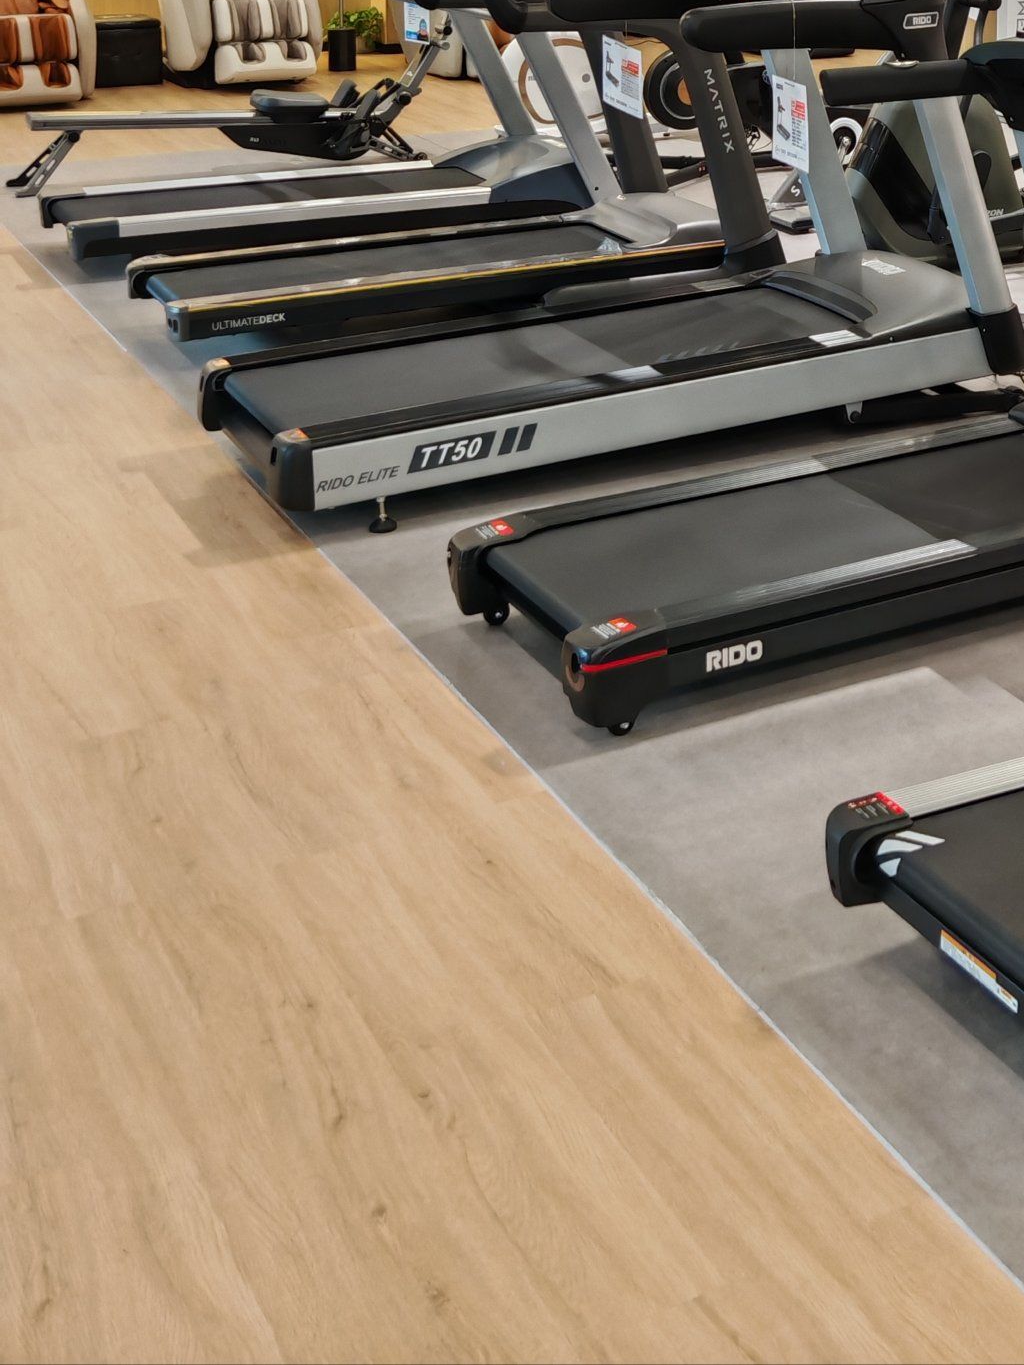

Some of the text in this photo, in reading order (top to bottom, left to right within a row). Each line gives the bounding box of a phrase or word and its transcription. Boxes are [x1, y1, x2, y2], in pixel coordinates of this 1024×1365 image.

[912, 15, 932, 25] RIDO
[704, 69, 735, 153] MATRIX
[211, 312, 286, 331] ULTIMATEDECK
[316, 437, 483, 493] RIDO ELITE TT50
[706, 639, 763, 673] RIDO
